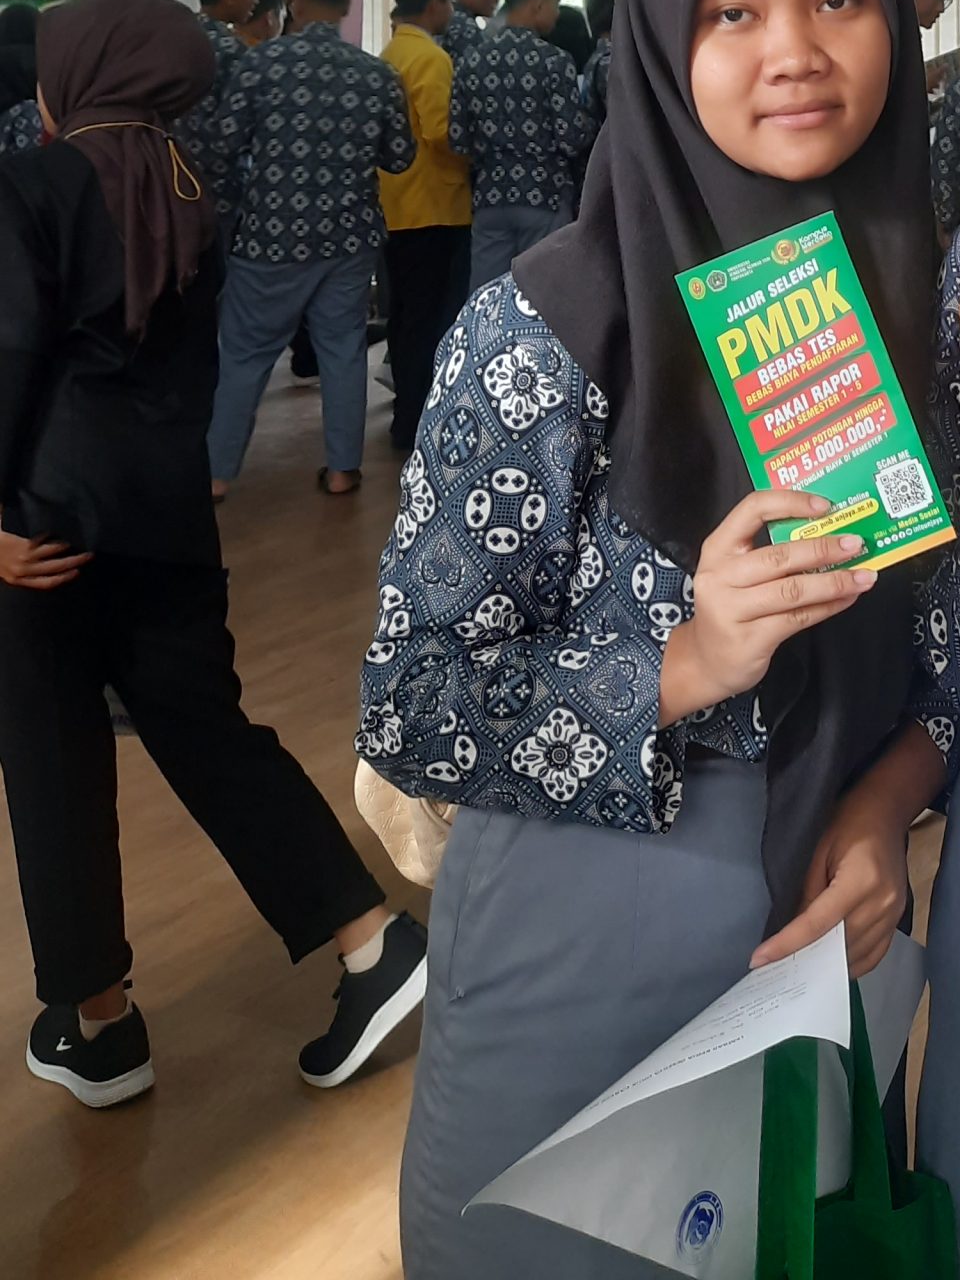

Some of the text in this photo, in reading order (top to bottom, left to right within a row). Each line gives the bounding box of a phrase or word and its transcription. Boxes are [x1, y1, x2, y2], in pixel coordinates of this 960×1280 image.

[727, 290, 766, 323] JALUR
[767, 258, 819, 298] SELEKSI
[717, 268, 852, 380] PMDK
[745, 333, 859, 406] BEBAS BIAYA PENDAFTARAN
[757, 328, 837, 386] BEBAS TES
[763, 363, 862, 431] PAKAI RAPOR
[773, 421, 796, 439] NILAI
[796, 393, 840, 425] SEMESTER
[841, 389, 847, 398] 1
[855, 380, 862, 391] 5
[770, 398, 885, 471] DAPATKAN POTONGAN HINGGA
[844, 454, 851, 462] DI
[851, 436, 883, 460] SEMESTER
[875, 449, 910, 470] SCAN ME
[777, 464, 799, 486] Rp
[848, 491, 869, 506] Online
[820, 502, 874, 530] pmb.unjaya.ac.id
[898, 515, 919, 531] Media
[919, 508, 940, 521] Sosial
